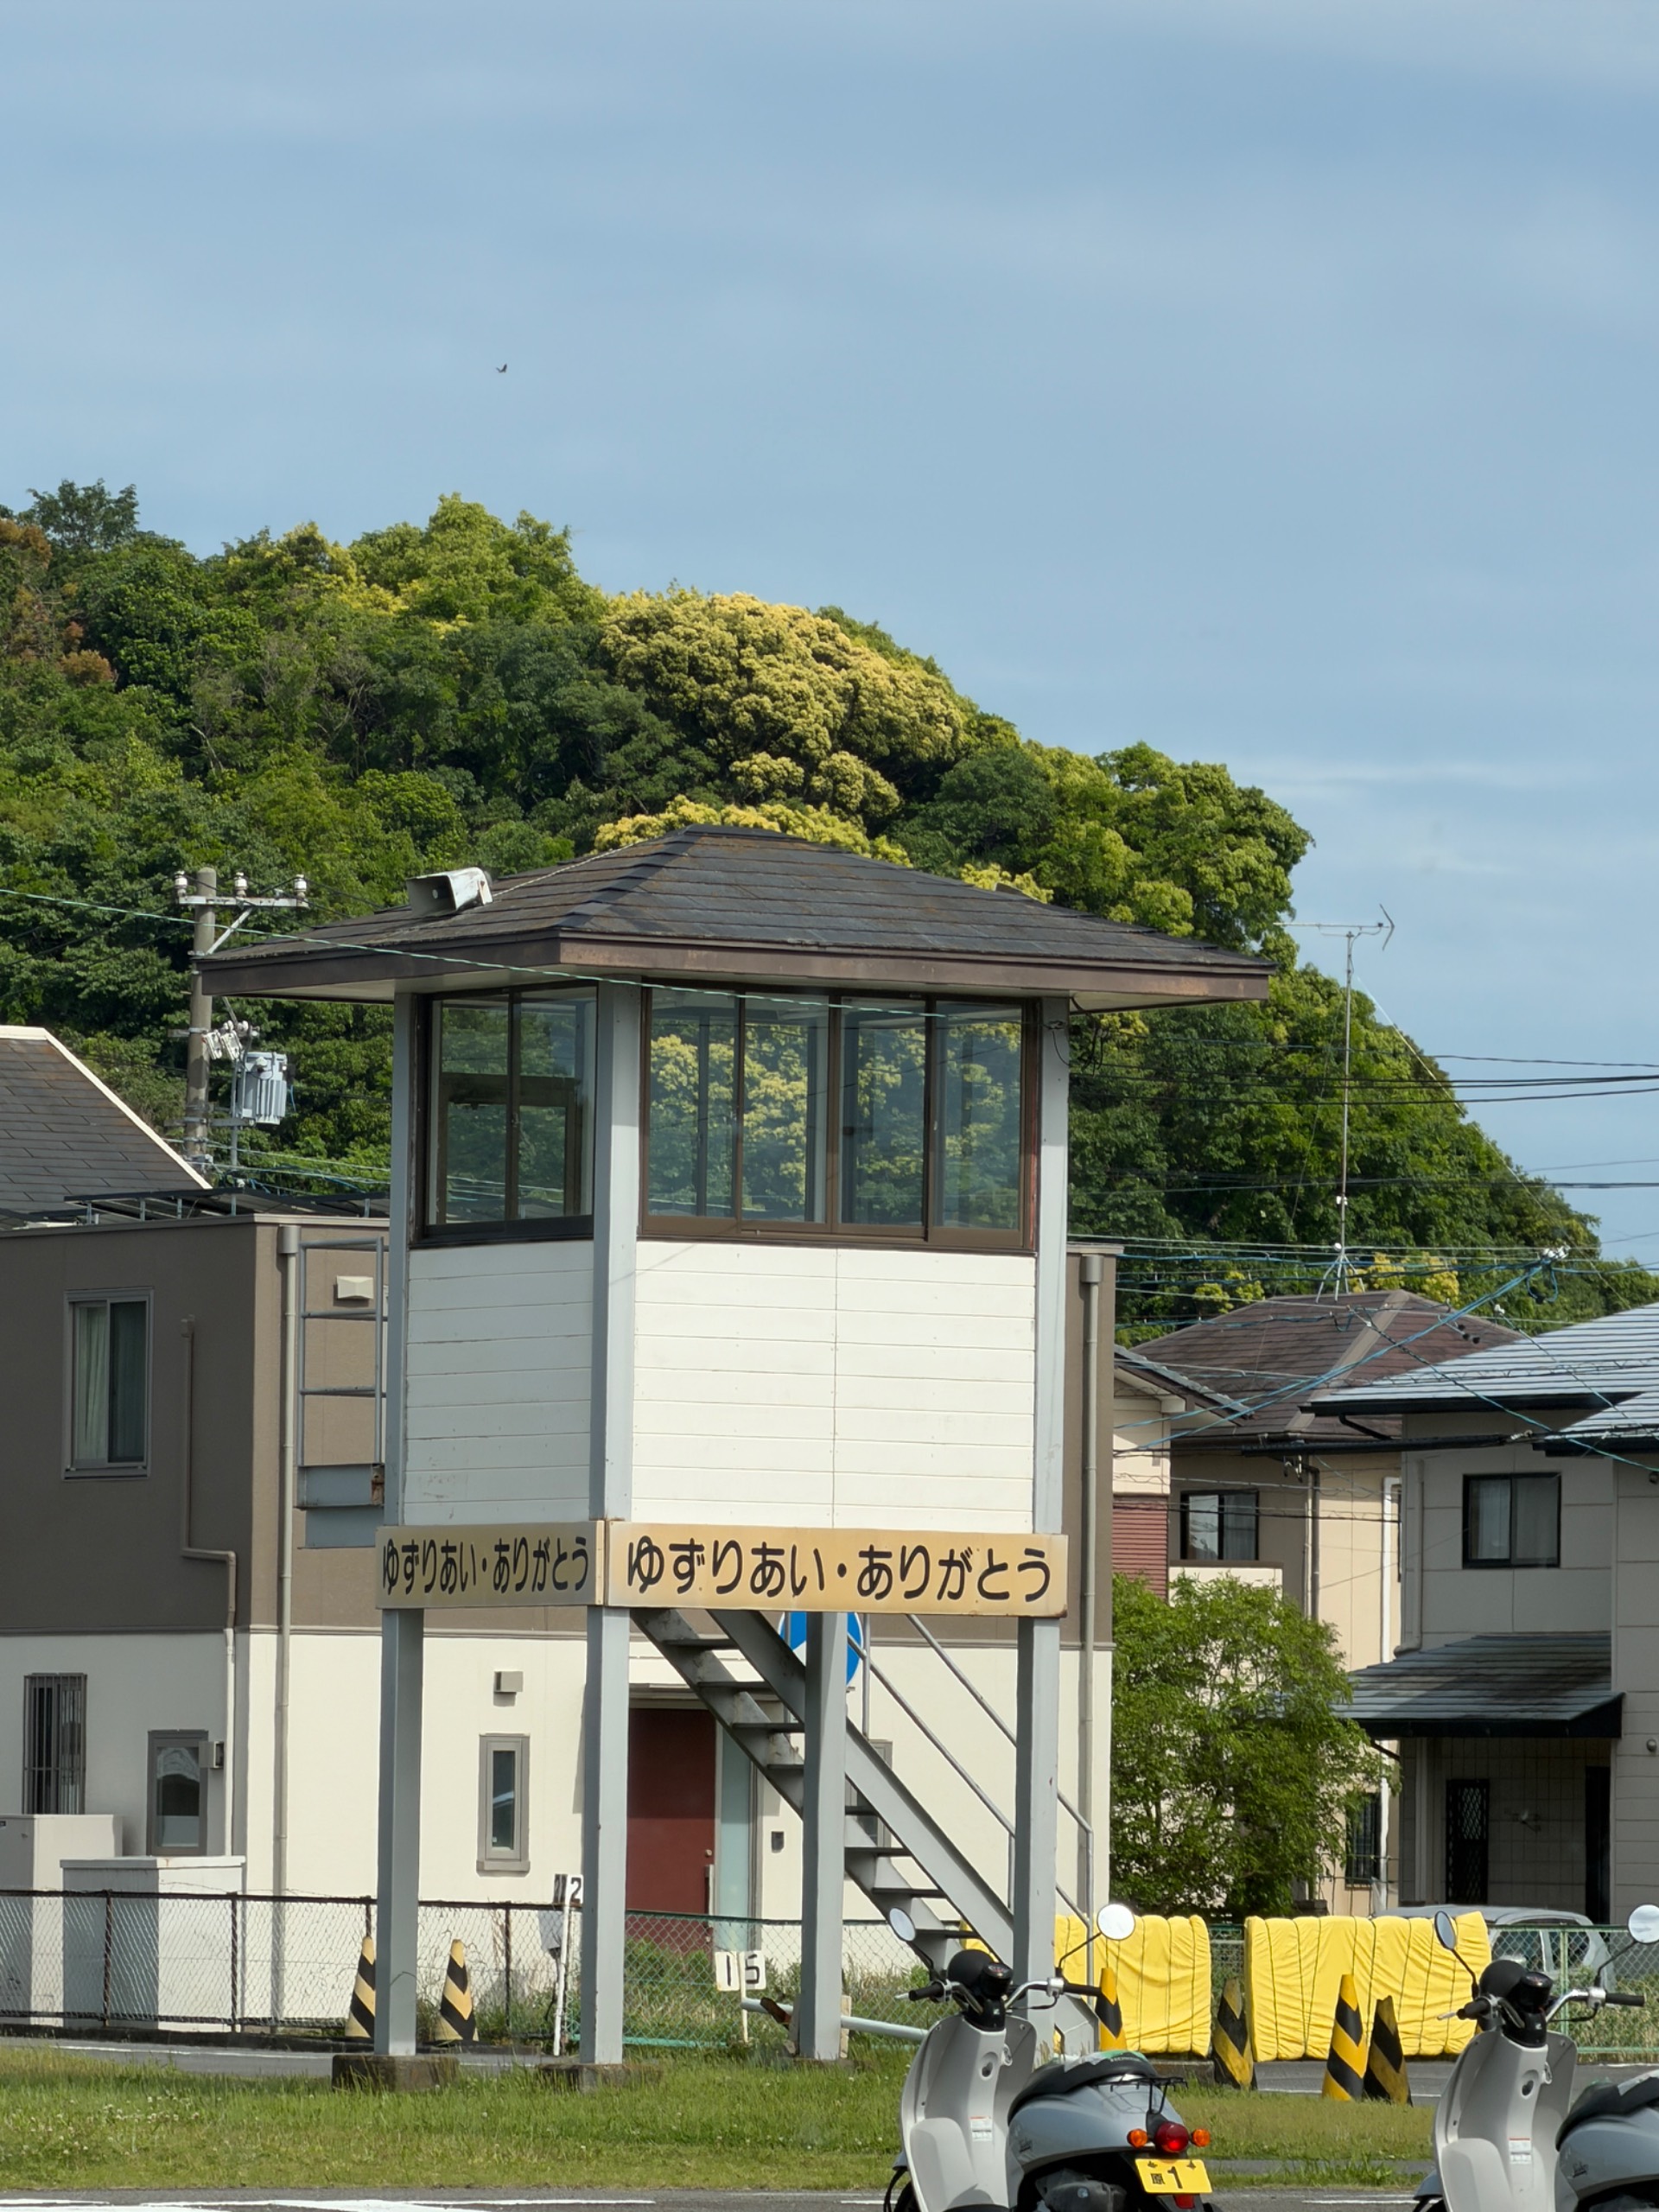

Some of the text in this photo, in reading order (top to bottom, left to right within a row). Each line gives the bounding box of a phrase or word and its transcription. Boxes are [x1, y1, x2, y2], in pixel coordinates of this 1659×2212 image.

[383, 1536, 588, 1595] ゆずりあい・ありがとう
[628, 1535, 1051, 1602] ゆずりあい・ありがとう
